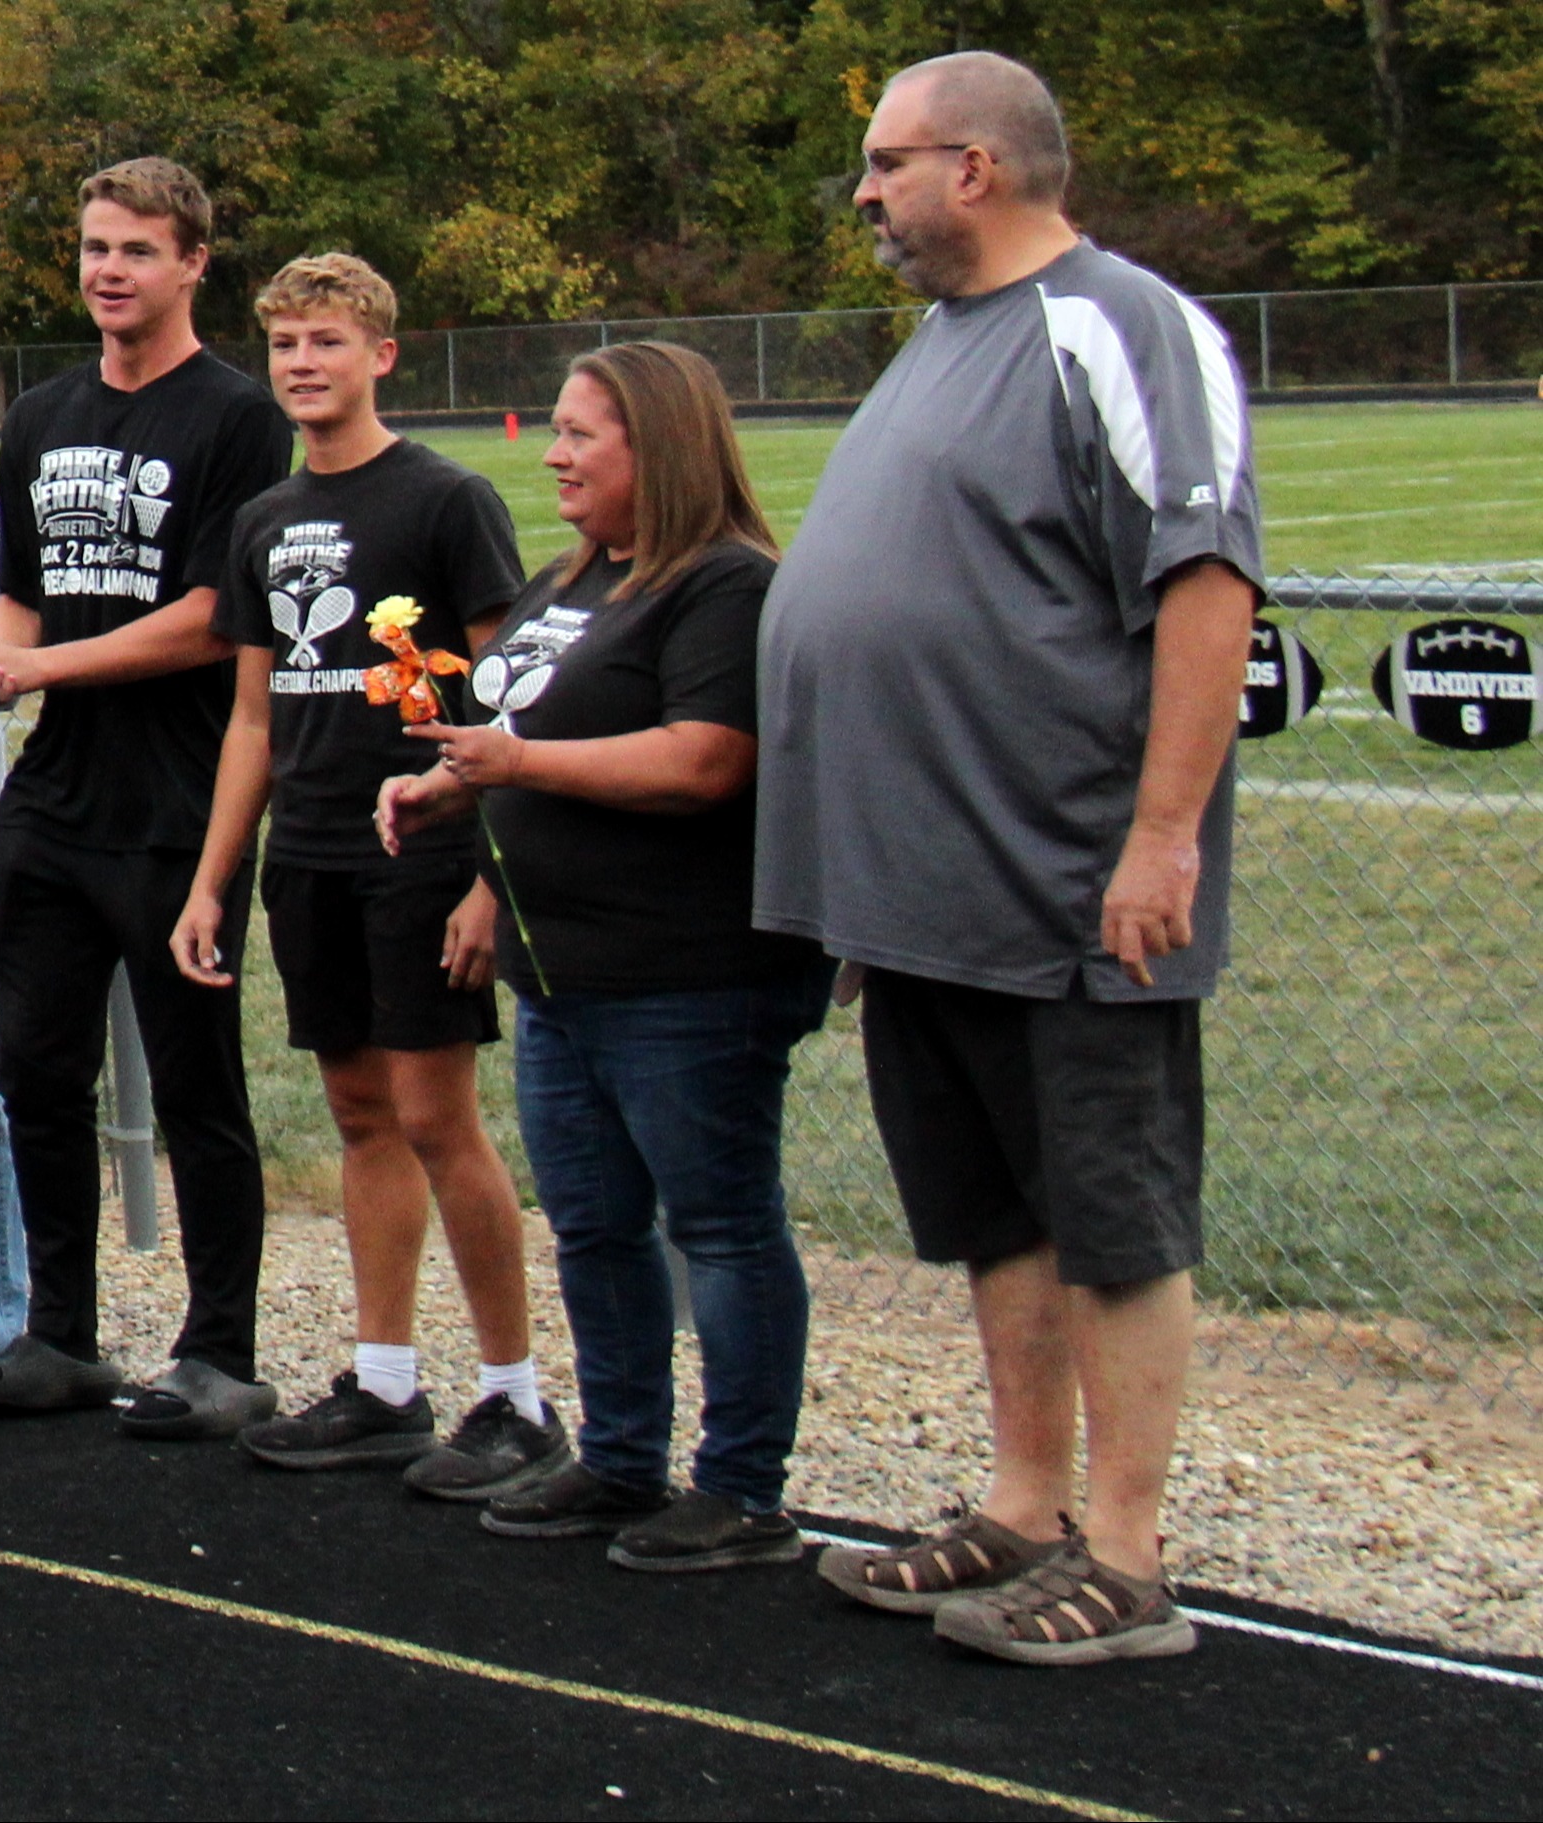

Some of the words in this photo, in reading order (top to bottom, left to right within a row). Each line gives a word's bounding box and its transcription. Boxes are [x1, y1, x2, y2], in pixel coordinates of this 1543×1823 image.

[41, 449, 123, 484] PARKE
[65, 540, 79, 567] 2
[1402, 669, 1539, 700] VANDIVIER
[1460, 703, 1484, 735] 6
